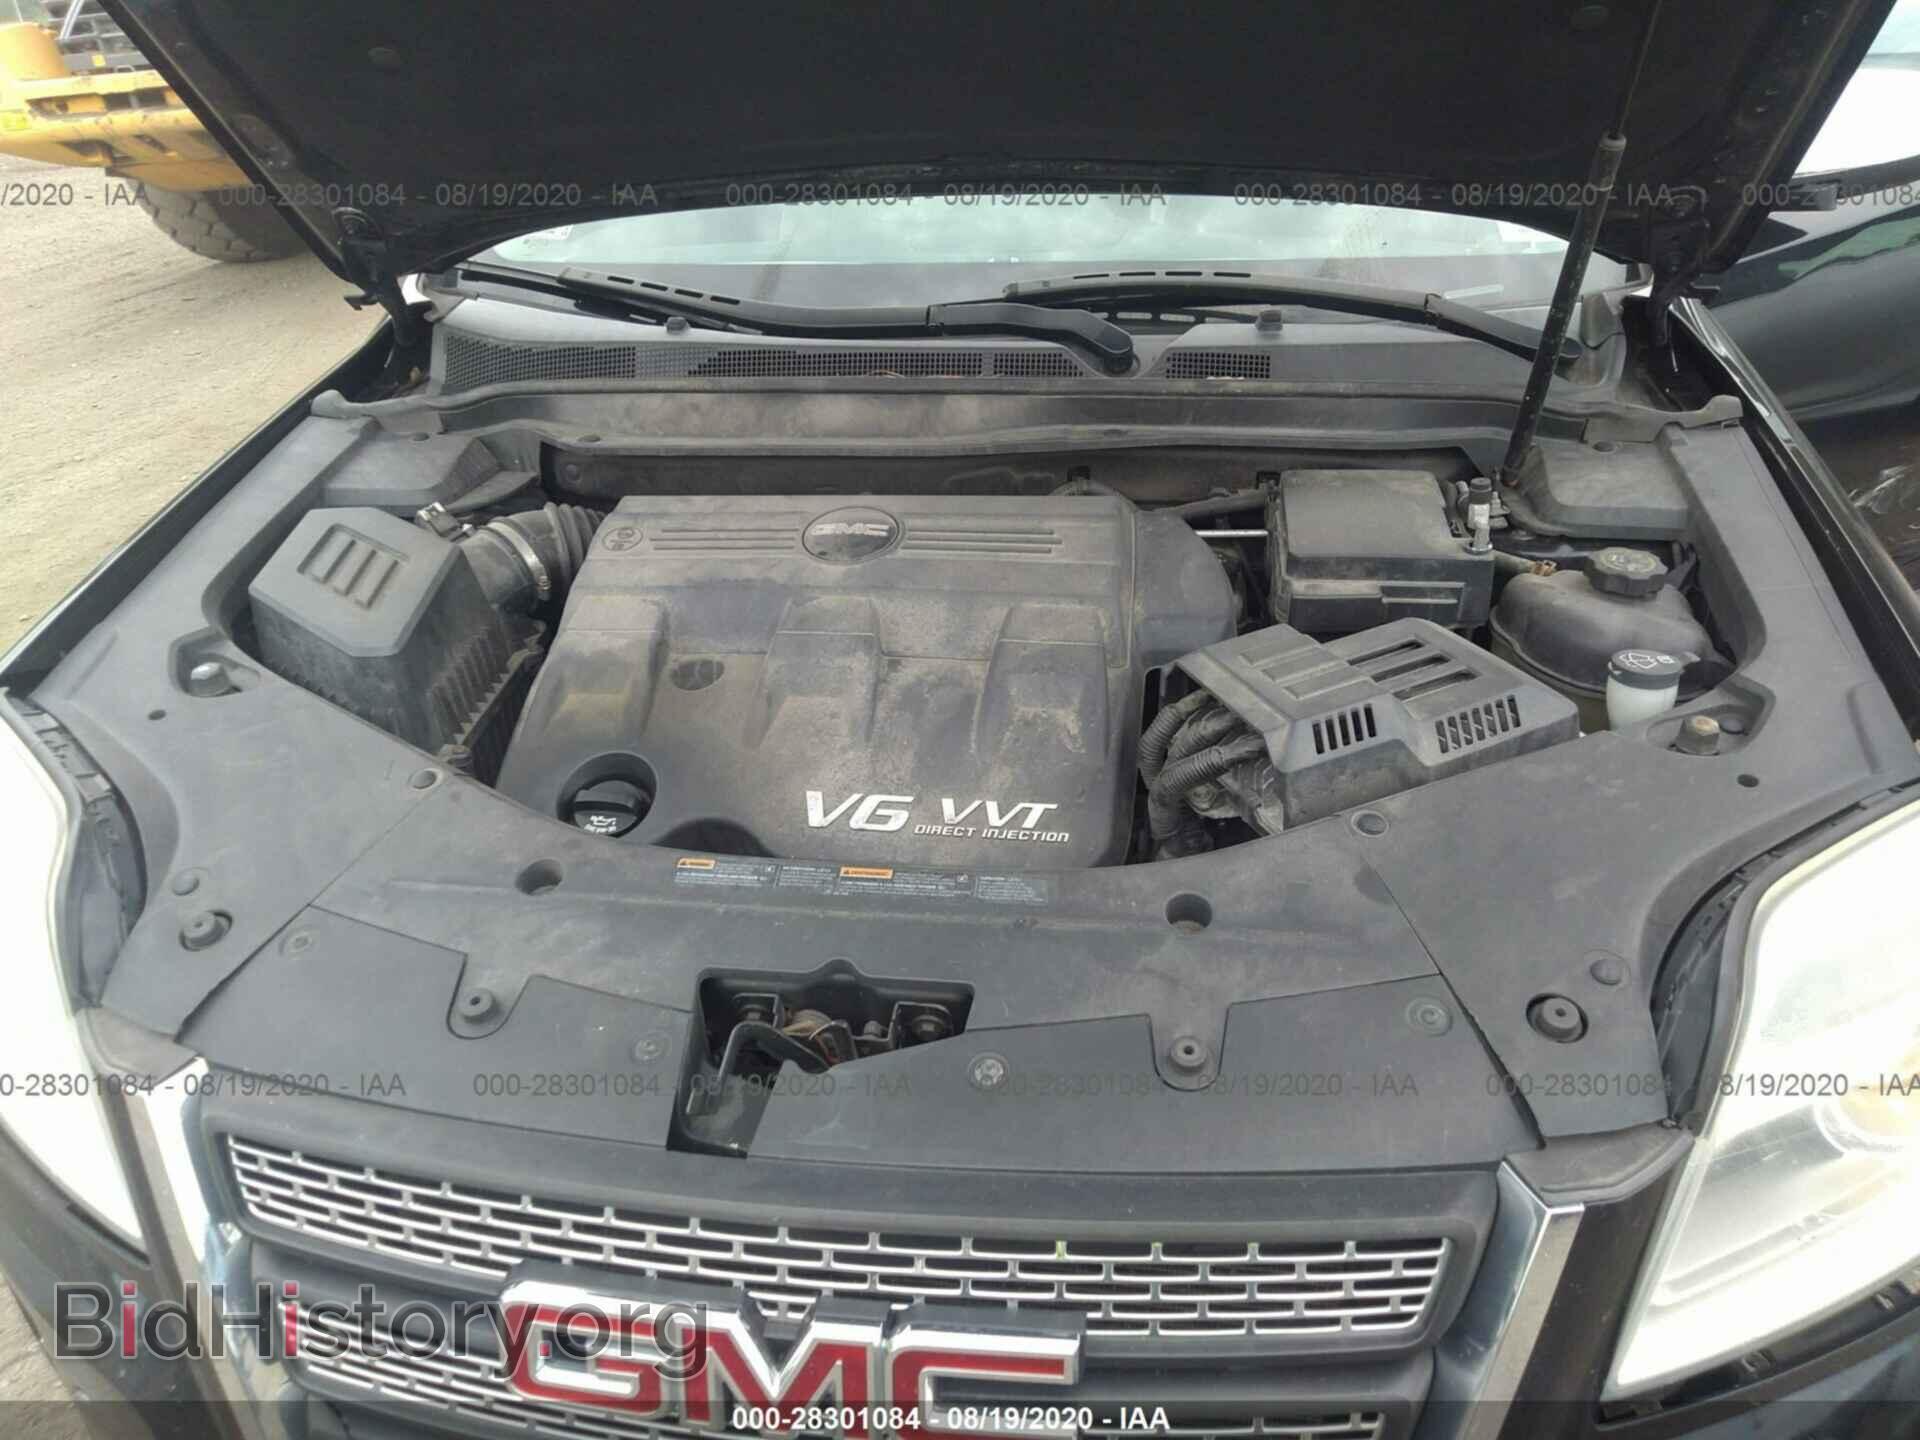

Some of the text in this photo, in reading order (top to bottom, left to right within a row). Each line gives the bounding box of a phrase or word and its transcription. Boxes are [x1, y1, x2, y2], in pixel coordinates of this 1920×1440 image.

[806, 790, 1058, 832] V6 VVT
[914, 823, 1070, 843] DIRECT INJECTION
[502, 1280, 1086, 1440] GMC
